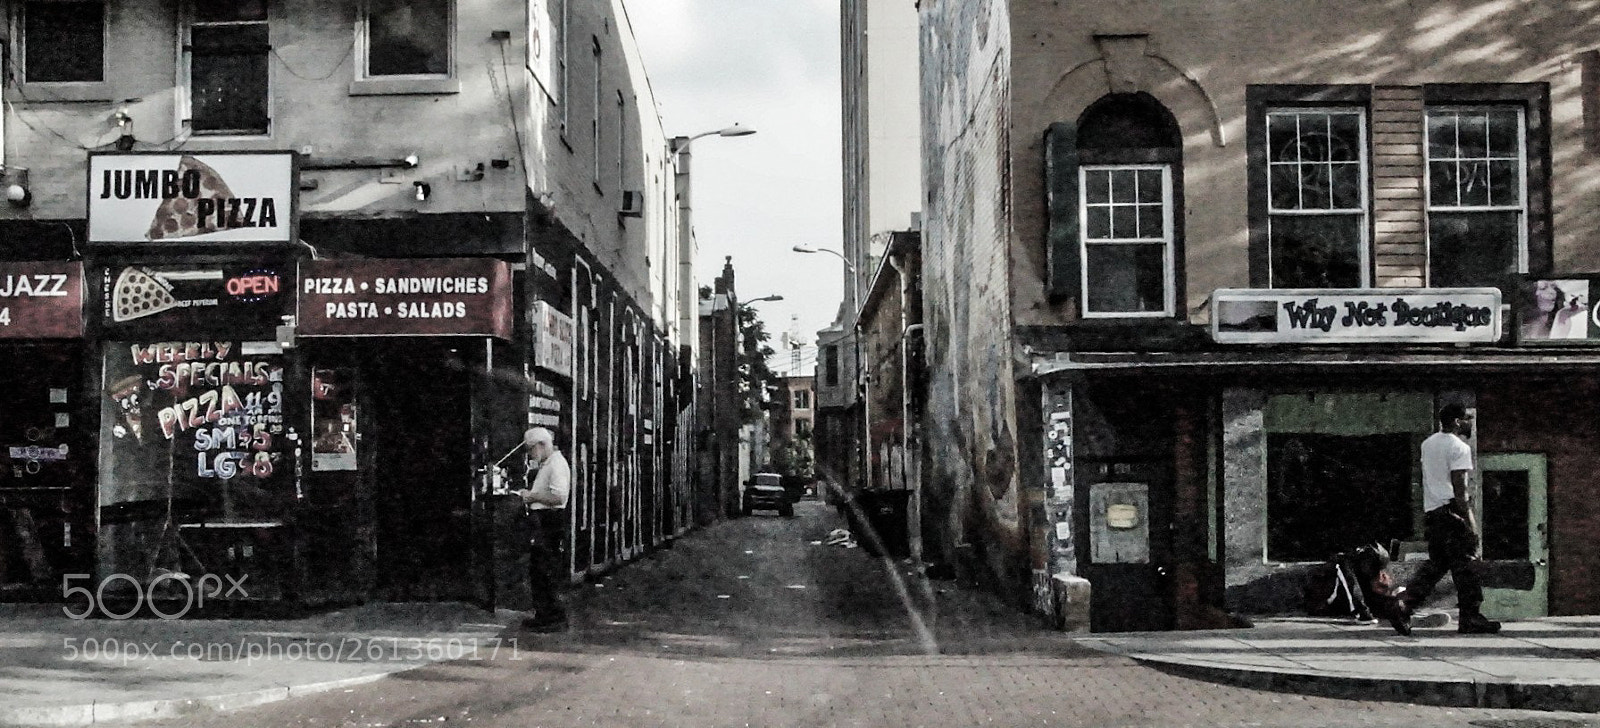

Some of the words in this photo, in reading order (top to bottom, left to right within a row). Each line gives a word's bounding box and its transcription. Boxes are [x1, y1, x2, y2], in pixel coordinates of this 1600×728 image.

[100, 169, 200, 199] JUMBO
[196, 197, 277, 228] PIZZA
[0, 274, 68, 297] JAZZ
[226, 275, 279, 296] OPEN
[304, 277, 355, 294] PIZZA
[375, 277, 489, 294] SANDWICHES
[326, 302, 379, 318] PASTA
[397, 302, 466, 318] SALADS
[1283, 298, 1337, 332] Why
[1341, 301, 1388, 327] Not
[131, 341, 231, 365] WEEKLY
[153, 361, 270, 390] SPECIALS
[157, 384, 245, 440] PIZZA
[218, 415, 241, 426] ONE
[194, 426, 236, 451] SM
[197, 451, 236, 480] LG
